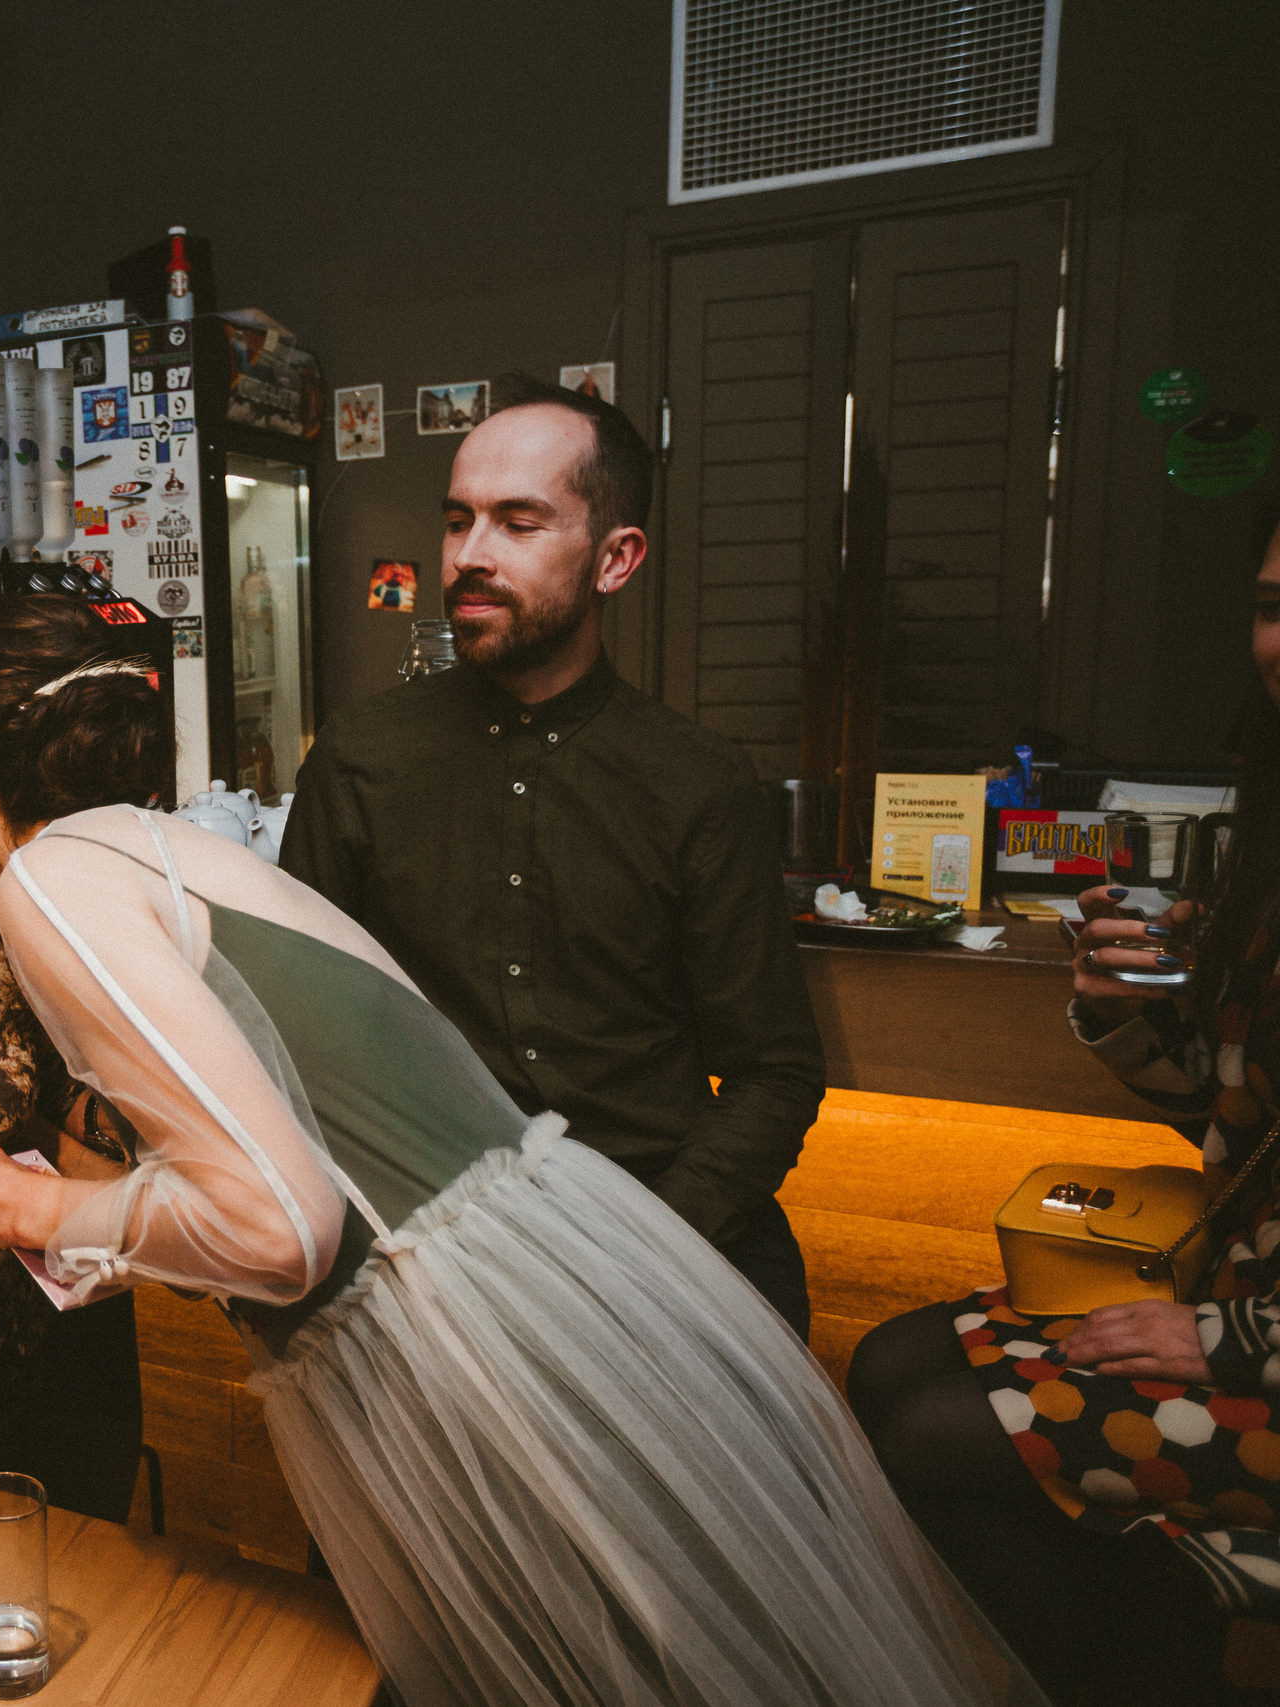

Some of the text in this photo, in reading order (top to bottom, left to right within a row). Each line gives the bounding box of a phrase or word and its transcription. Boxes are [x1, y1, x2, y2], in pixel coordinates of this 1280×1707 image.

[132, 366, 192, 393] 19 87
[139, 396, 186, 419] 1 9
[138, 437, 187, 460] 8 7
[887, 796, 958, 807] Установите
[886, 809, 965, 820] приложение
[1006, 821, 1105, 862] БРАТЬЯ
